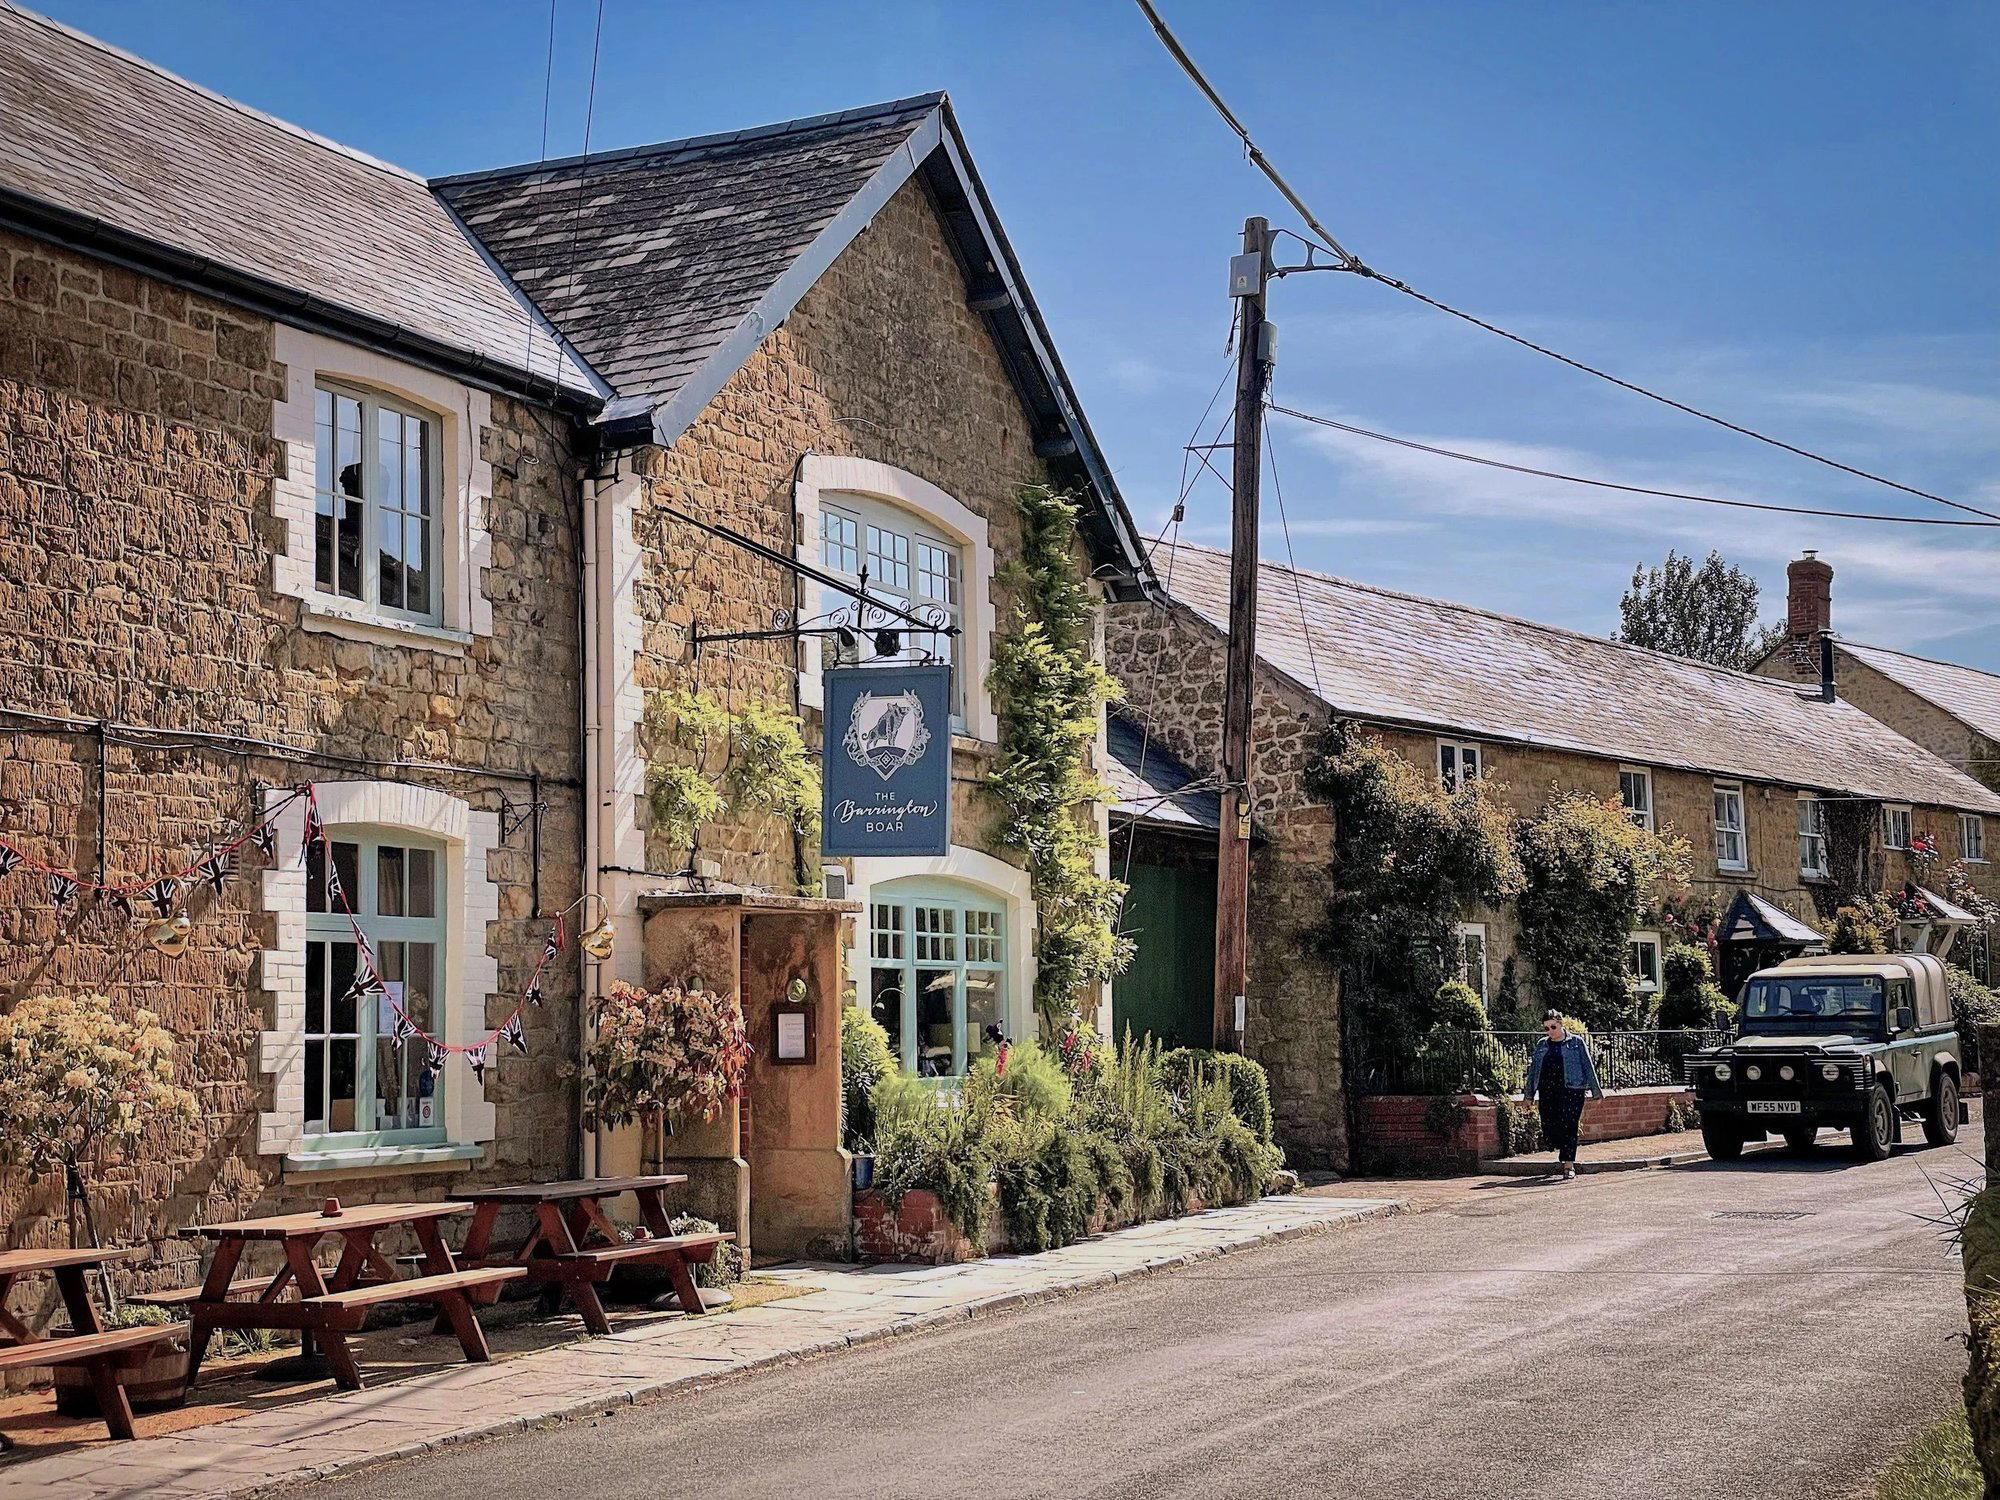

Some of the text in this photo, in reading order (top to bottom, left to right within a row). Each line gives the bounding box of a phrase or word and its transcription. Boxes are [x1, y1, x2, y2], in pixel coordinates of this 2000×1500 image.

[875, 792, 895, 801] THE
[833, 799, 938, 824] Barrington
[866, 822, 904, 832] BOAR
[1751, 1103, 1775, 1111] WF55
